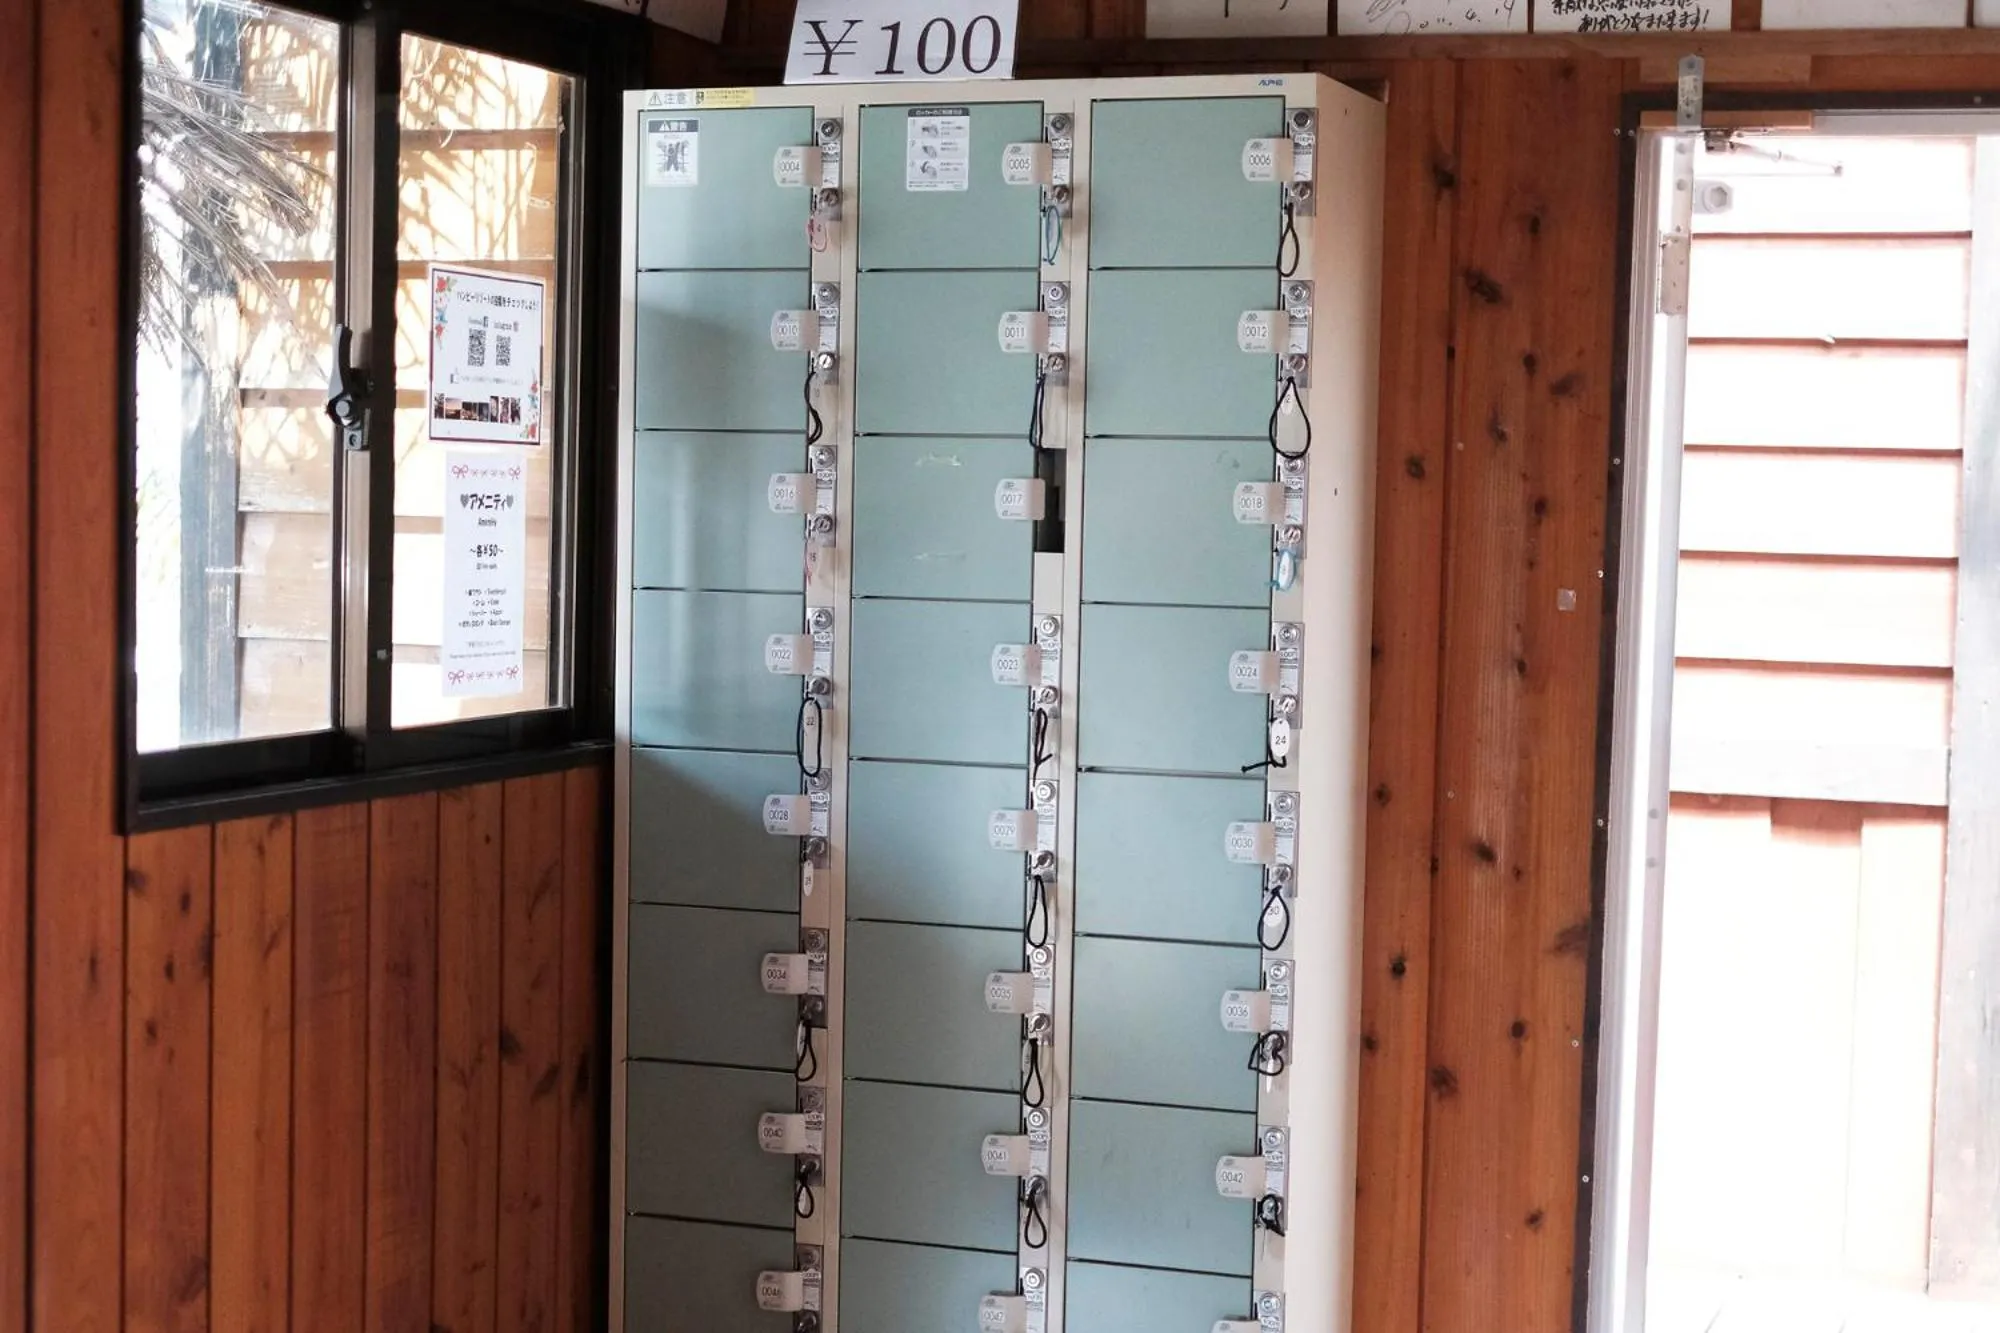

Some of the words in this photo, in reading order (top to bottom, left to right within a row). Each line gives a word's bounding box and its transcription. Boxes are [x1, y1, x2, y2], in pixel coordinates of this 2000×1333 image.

[803, 15, 1001, 76] ¥100
[1008, 158, 1030, 169] 0005
[1248, 154, 1271, 165] 0006
[780, 159, 800, 171] 0004
[778, 325, 797, 336] 0010
[1004, 327, 1024, 338] 0011
[1244, 327, 1267, 337] 0012
[774, 488, 794, 499] 0016
[469, 493, 507, 511] アメニティ
[1001, 494, 1023, 504] 0017
[1239, 498, 1263, 508] 0018
[771, 649, 791, 660] 0022
[1235, 666, 1257, 676] 0024
[806, 716, 815, 726] 22
[1275, 735, 1287, 745] 24
[768, 810, 789, 820] 0028
[1231, 838, 1253, 848] 0030
[766, 969, 786, 979] 0034
[990, 988, 1010, 999] 0035
[1226, 1007, 1248, 1017] 0036
[763, 1128, 782, 1137] 0040
[987, 1151, 1007, 1160] 0041
[1221, 1172, 1243, 1182] 0042
